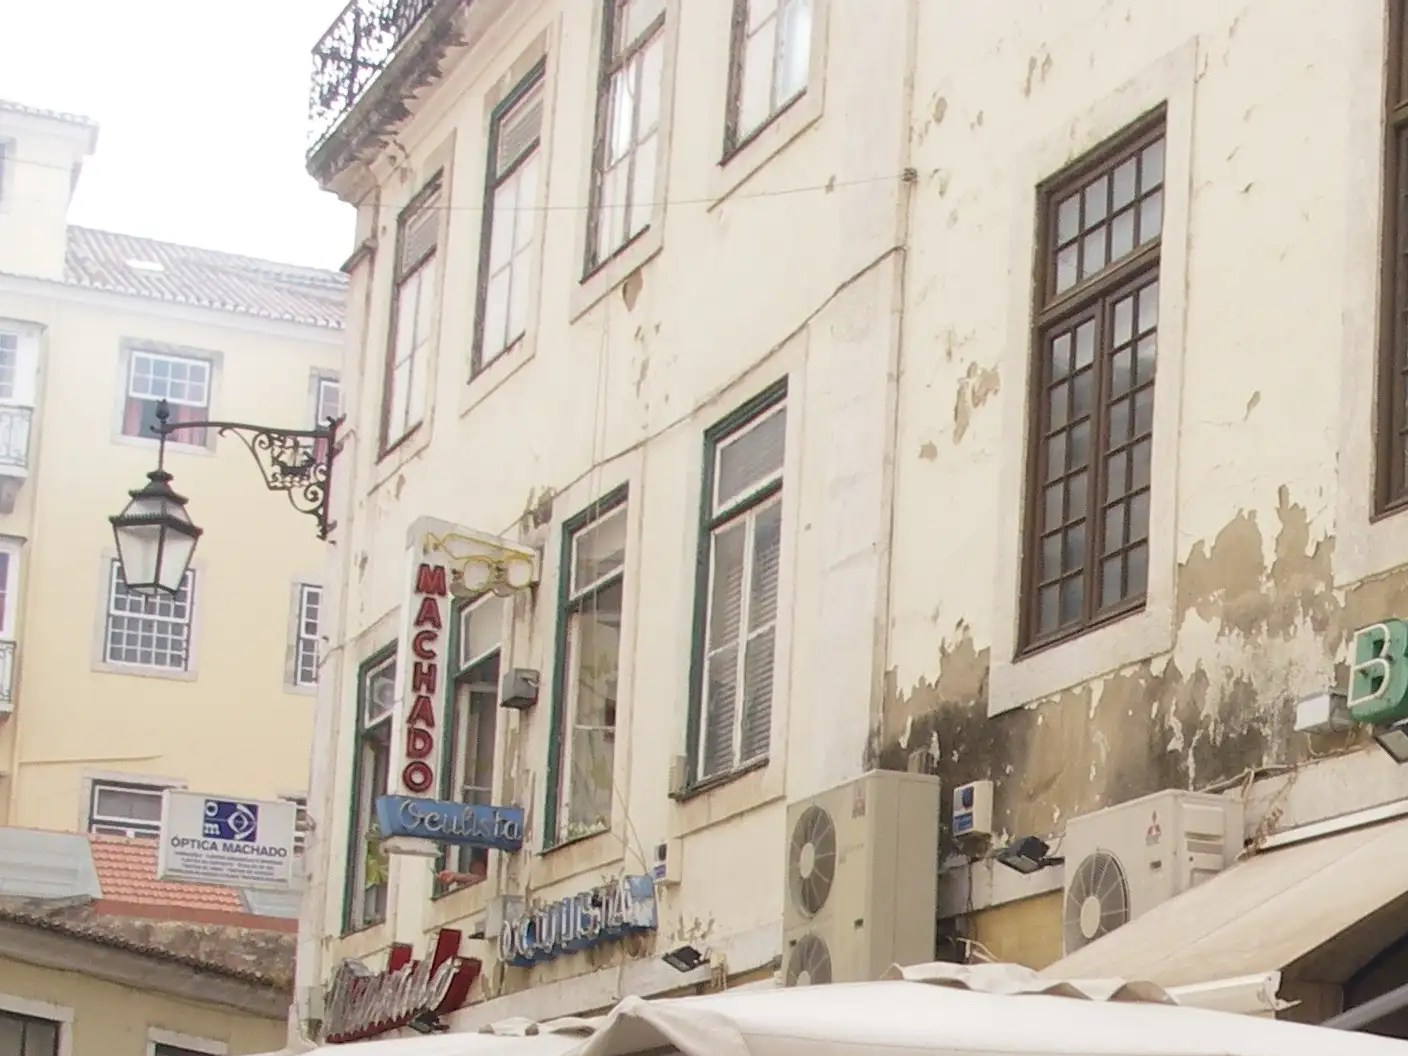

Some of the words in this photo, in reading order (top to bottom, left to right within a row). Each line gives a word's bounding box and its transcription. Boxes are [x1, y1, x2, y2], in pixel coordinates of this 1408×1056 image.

[402, 562, 447, 794] MACHADO
[170, 834, 219, 852] ÓPTICA
[222, 842, 288, 858] MACHADO
